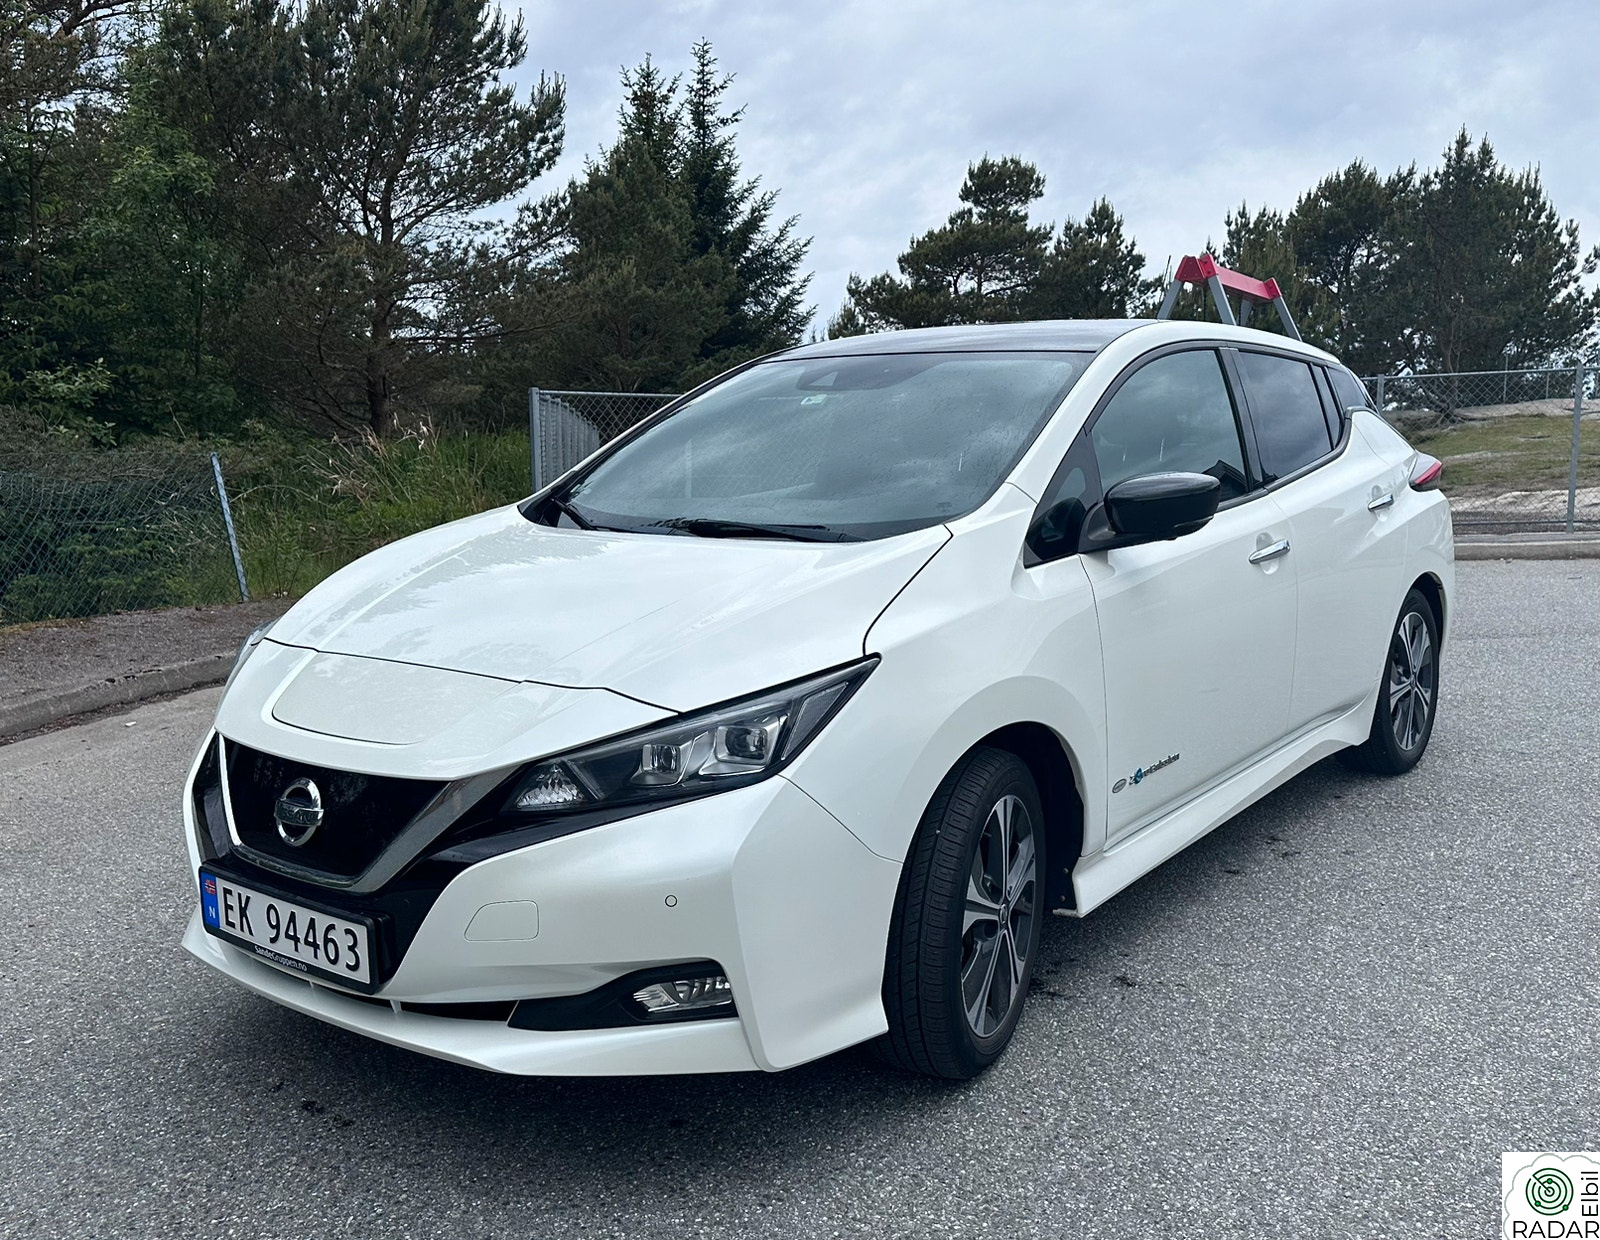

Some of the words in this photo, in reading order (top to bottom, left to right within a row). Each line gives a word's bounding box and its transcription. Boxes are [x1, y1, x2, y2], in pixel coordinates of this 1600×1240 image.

[209, 906, 216, 919] N
[222, 886, 254, 937] EK
[265, 903, 361, 973] 94463
